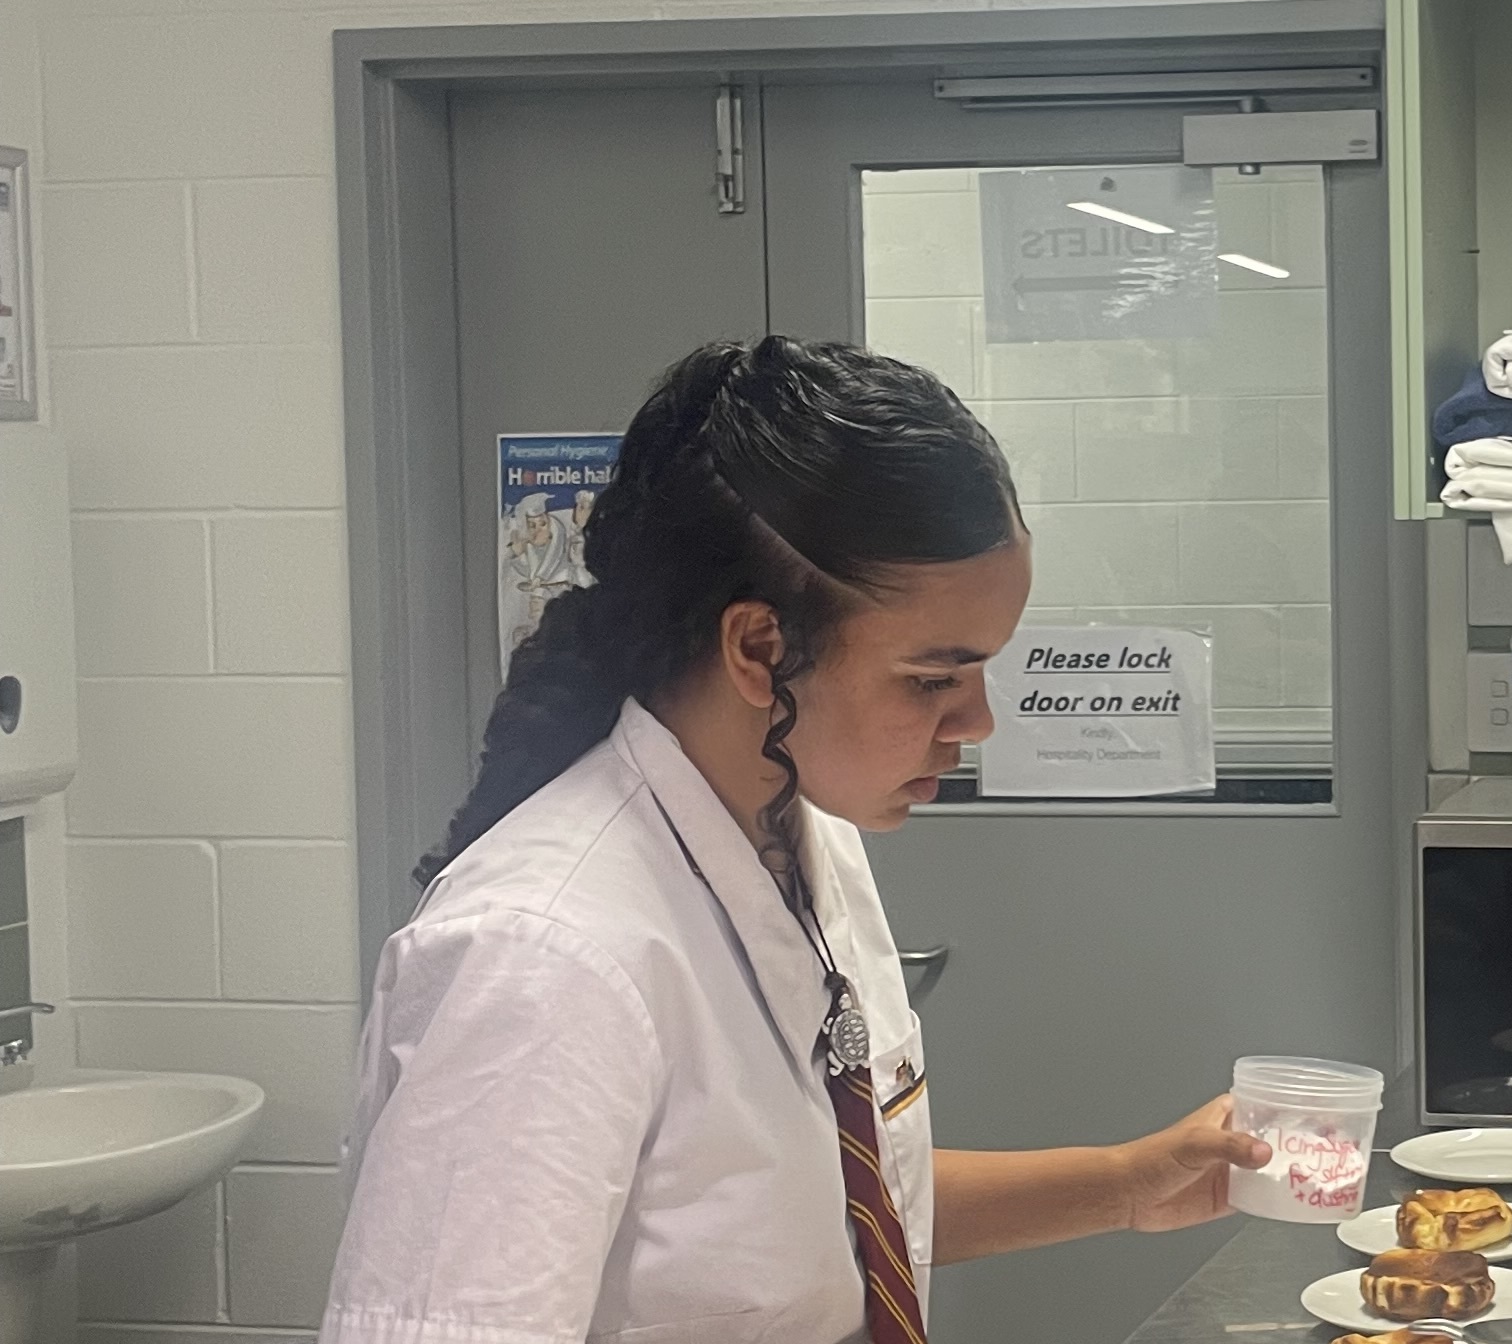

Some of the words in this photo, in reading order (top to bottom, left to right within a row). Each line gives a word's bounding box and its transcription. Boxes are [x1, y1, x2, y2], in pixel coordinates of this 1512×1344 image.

[1025, 646, 1111, 670] Please
[1117, 646, 1172, 669] lock
[1019, 689, 1084, 712] door
[1089, 695, 1123, 712] on
[1130, 688, 1181, 712] exit
